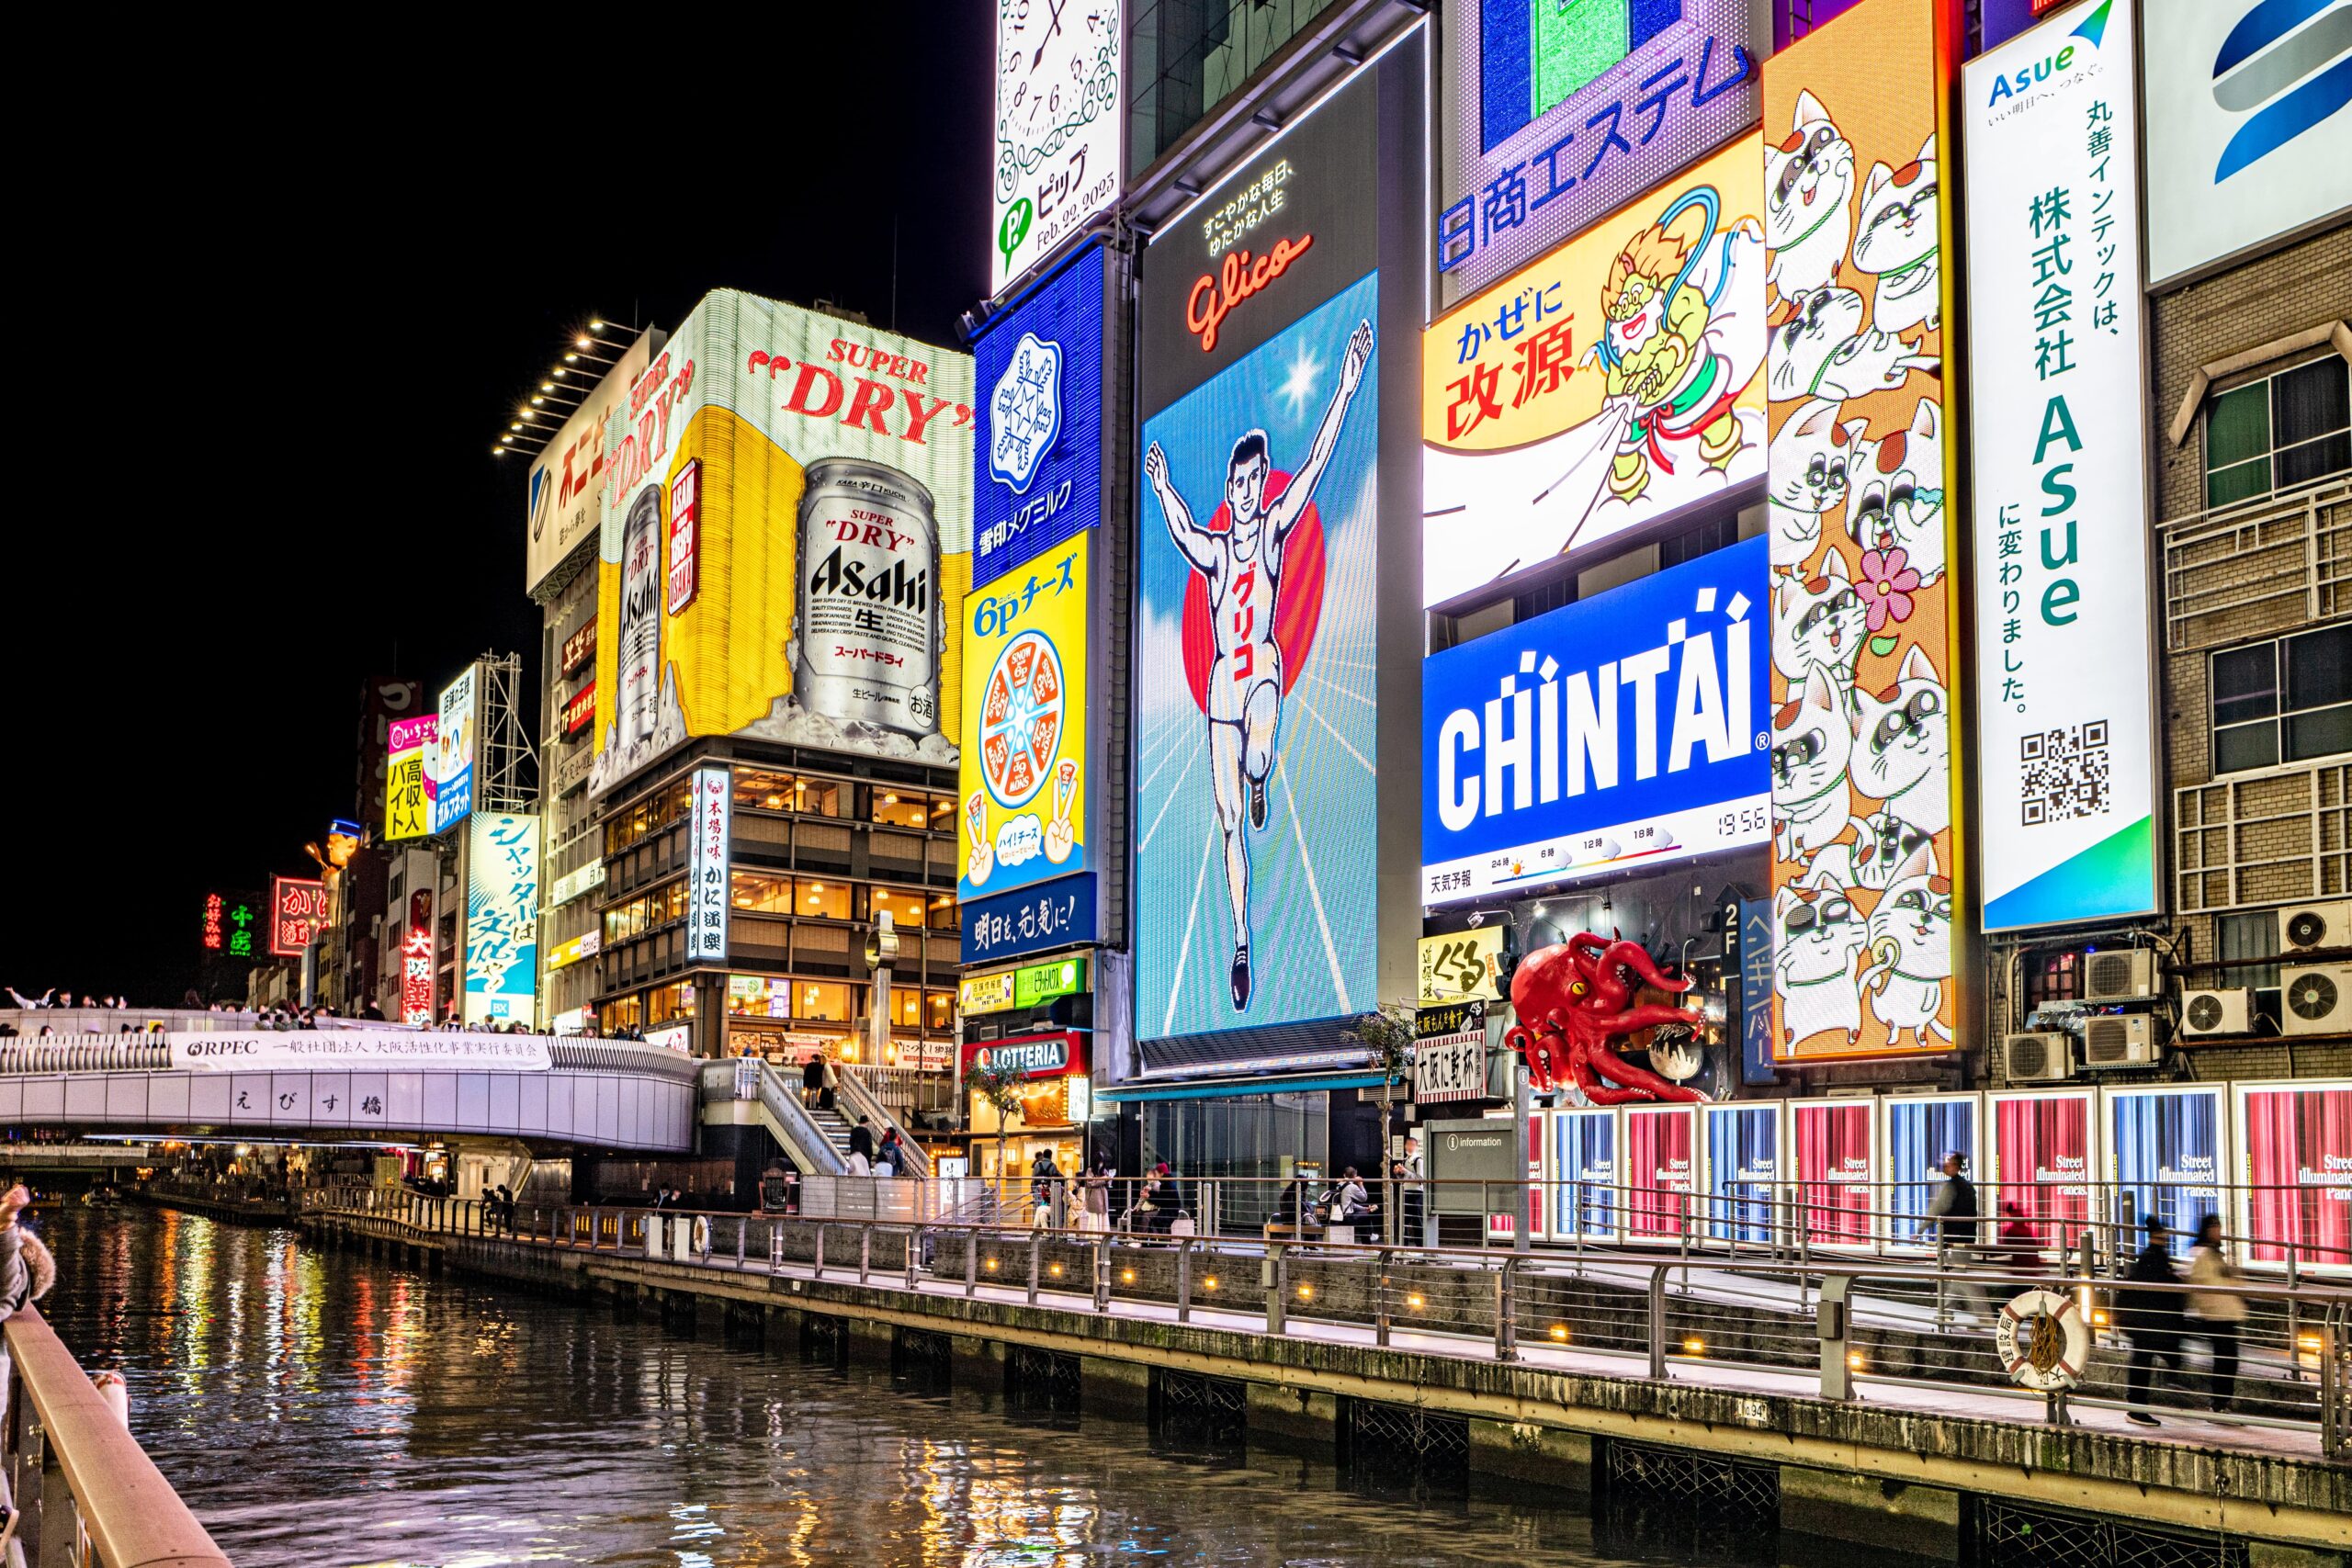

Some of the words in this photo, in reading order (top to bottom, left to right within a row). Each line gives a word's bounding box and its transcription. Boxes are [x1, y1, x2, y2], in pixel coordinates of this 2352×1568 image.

[1988, 45, 2075, 108] Asue
[1439, 36, 1750, 274] 日商エステム
[1038, 143, 1088, 220] ピップ
[1204, 160, 1295, 240] すこやかな毎日、
[1037, 221, 1061, 251] Feb.
[1082, 171, 1114, 212] 2023
[1209, 189, 1284, 257] ゆたかな人生
[2086, 99, 2120, 336] 丸善インテックは、
[1457, 280, 1563, 365] かぜに
[827, 337, 929, 385] SUPER
[1445, 312, 1578, 442] 改源
[629, 351, 670, 421] SUPER
[672, 469, 695, 523] ASAHI
[850, 509, 894, 527] SUPER
[979, 480, 1072, 558] 雪印メグミルク
[671, 519, 694, 568] 1889
[669, 560, 692, 607] OSAKA
[810, 545, 926, 615] Asahi
[622, 569, 658, 642] Asahi
[853, 600, 874, 608] BREWED
[888, 607, 910, 618] PRECISION
[854, 608, 885, 633] 生
[887, 615, 904, 624] UNDER
[887, 622, 907, 633] MASTER
[1231, 561, 1256, 682] グリコ
[1998, 502, 2027, 715] に変わりました。
[634, 632, 643, 654] 生
[834, 646, 904, 668] スーパードライ
[1012, 645, 1033, 664] SNOW
[1439, 587, 1752, 831] CHINTAI
[390, 761, 407, 836] バイト
[406, 759, 423, 833] 高収入
[437, 786, 470, 827] ガルフネット
[707, 798, 722, 861] 本場の味
[1583, 838, 1603, 850] 12時
[1634, 827, 1654, 840] 18時
[1491, 856, 1510, 868] 24時
[1541, 848, 1555, 859] 6時
[1430, 869, 1472, 894] 天気予報
[703, 866, 722, 951] かに道楽
[1725, 903, 1737, 954] 2F
[1422, 944, 1433, 999] 道頓堀
[1433, 940, 1486, 993] くくる
[492, 1003, 507, 1015] BX
[273, 1040, 369, 1054] 一般社団法人
[993, 1043, 1060, 1068] LOTTERIA
[1419, 1044, 1474, 1092] 大阪に乾杯
[236, 1090, 382, 1116] えびす橋
[1460, 1137, 1502, 1147] information
[1669, 1157, 1689, 1169] Street
[1753, 1157, 1773, 1169] Street
[1844, 1156, 1867, 1169] Street
[2055, 1155, 2084, 1168] Street
[2180, 1154, 2213, 1169] Street
[2036, 1167, 2086, 1182] Illuminated
[2159, 1166, 2215, 1183] Illuminated
[2299, 1168, 2352, 1184] Illuminate
